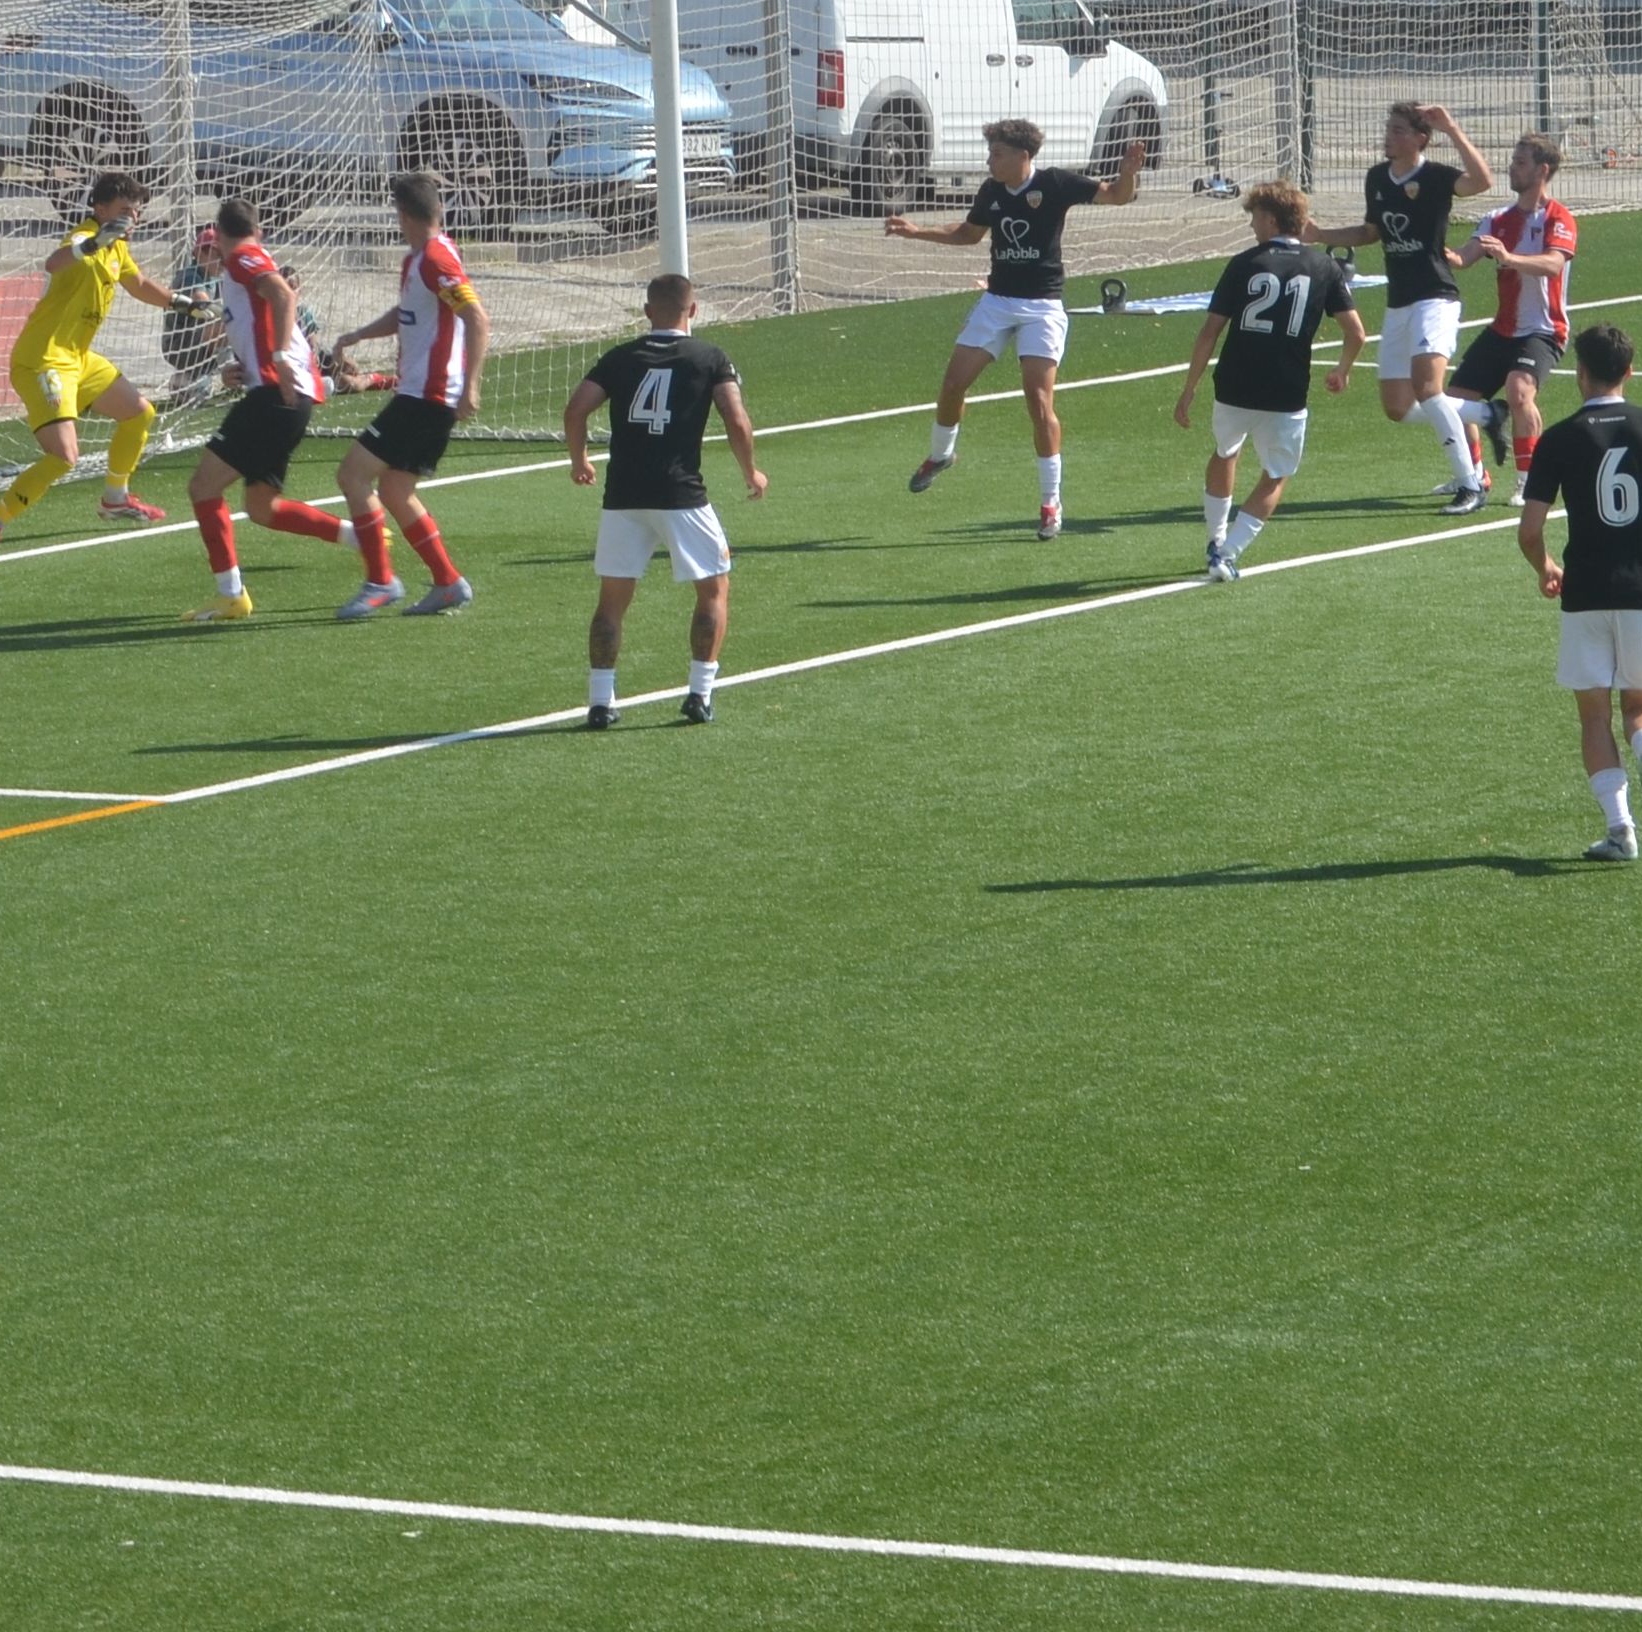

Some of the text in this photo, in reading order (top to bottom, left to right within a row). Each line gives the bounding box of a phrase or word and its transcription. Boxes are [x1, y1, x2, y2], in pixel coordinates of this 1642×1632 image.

[1239, 271, 1312, 338] 21
[627, 367, 673, 436] 4
[1595, 445, 1640, 528] 6
